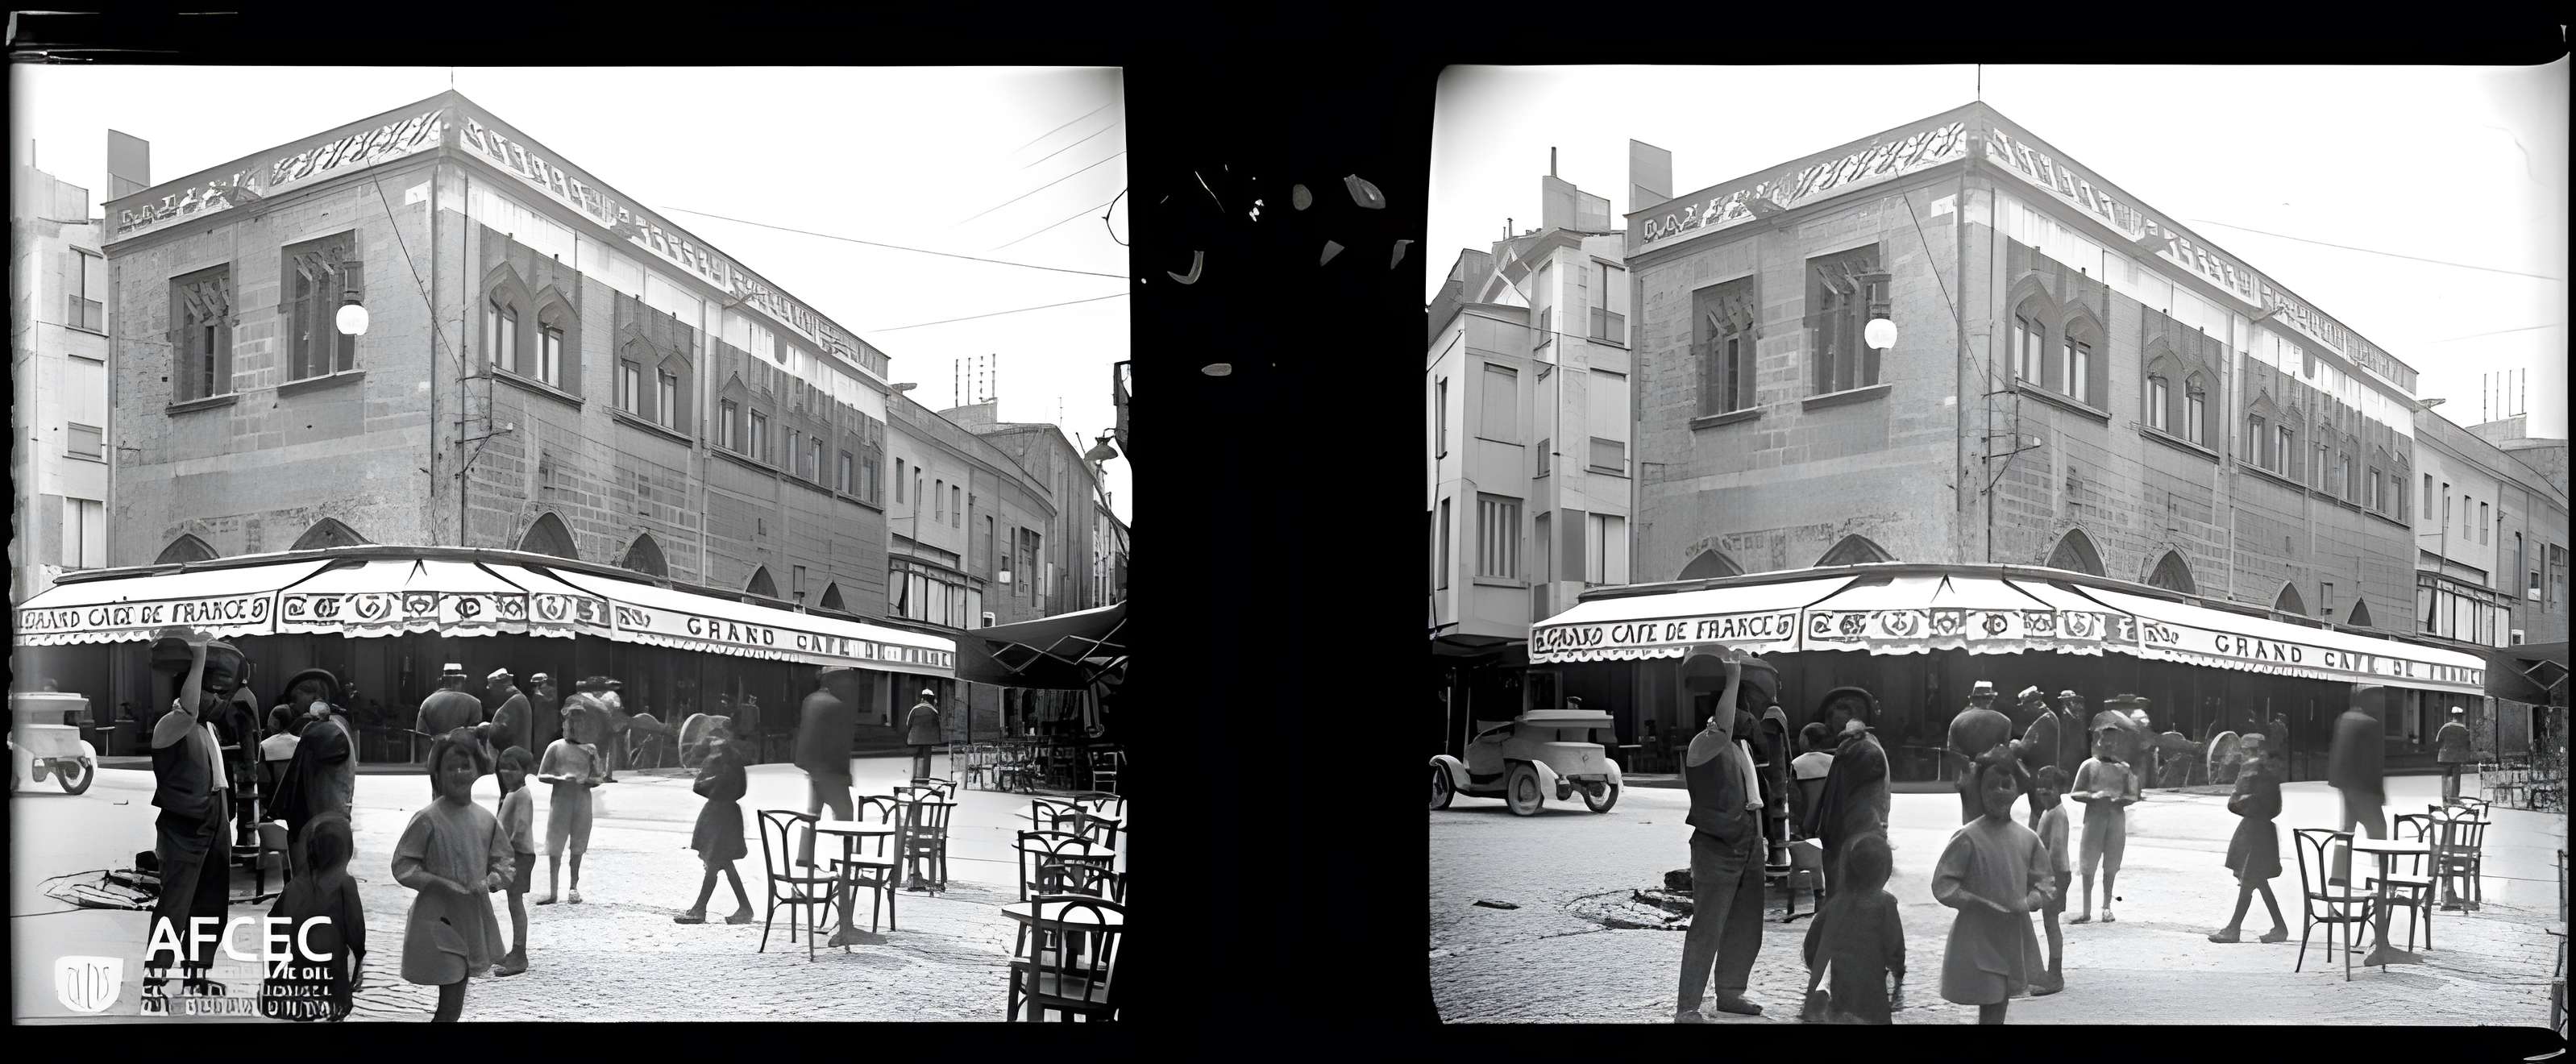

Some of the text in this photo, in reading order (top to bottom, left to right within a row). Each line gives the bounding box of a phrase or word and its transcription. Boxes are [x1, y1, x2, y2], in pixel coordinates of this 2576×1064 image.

[172, 599, 248, 623] FRANCE
[688, 617, 775, 646] GRAND
[1666, 621, 1688, 641] DE
[1696, 615, 1773, 639] FRANCE
[2215, 634, 2303, 663] GRAND
